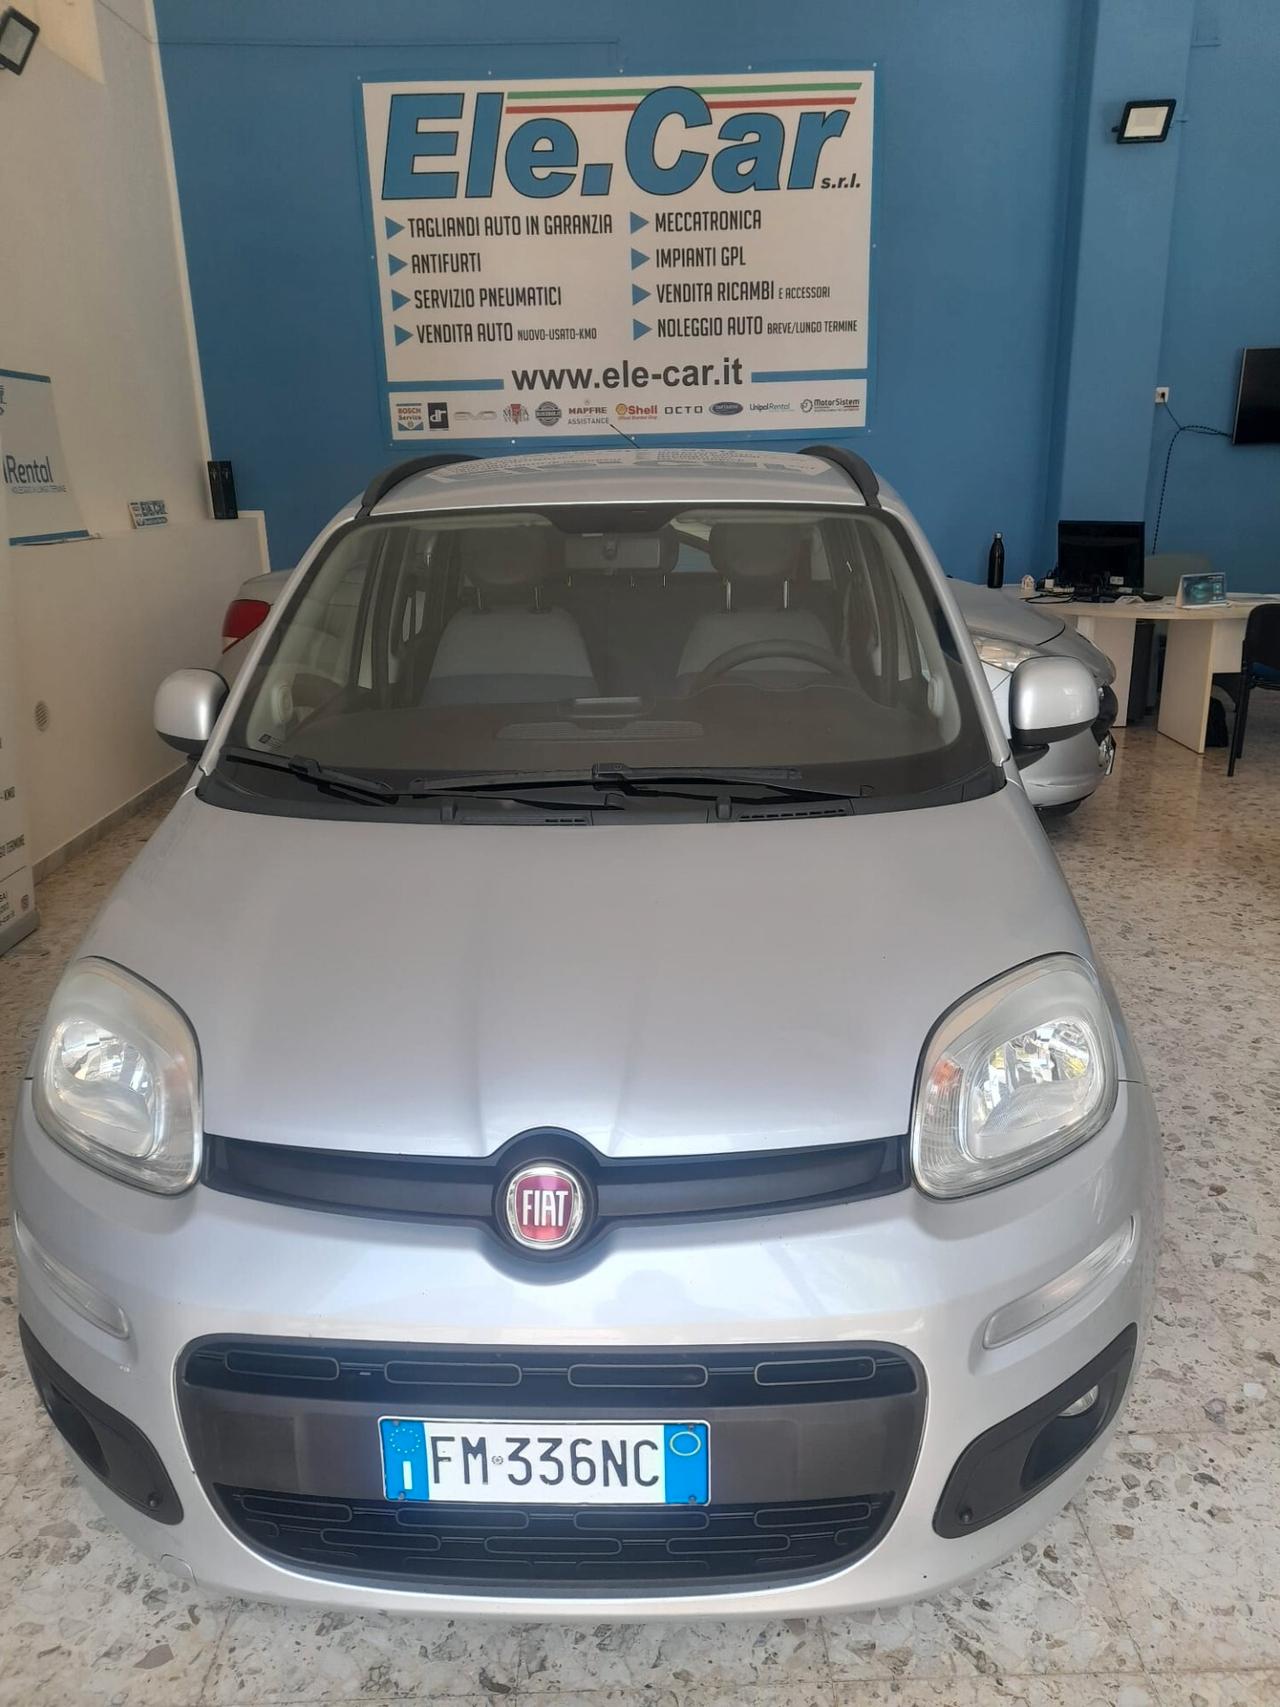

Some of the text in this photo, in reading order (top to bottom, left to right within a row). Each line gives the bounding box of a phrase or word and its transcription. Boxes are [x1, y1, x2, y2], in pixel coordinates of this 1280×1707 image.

[820, 173, 861, 189] s.r.l.
[408, 214, 613, 238] TAGLIANDI AUTO IN GARANZIA
[655, 209, 762, 232] MECCATRONICA
[411, 252, 481, 274] ANTIFURTI
[656, 246, 746, 268] IMPIANTI GPL
[414, 286, 562, 309] SERVIZIO PNEUMATICI
[656, 280, 831, 303] VENDITA RICAMBI E ACCESSORI
[416, 324, 473, 344] VENDITA
[477, 322, 513, 342] AUTO
[657, 316, 858, 338] NOLEGGIO AUTO BREVE/LUNGO TERMINE
[511, 357, 743, 391] www.ele-car.it
[568, 406, 608, 414] MAPFRE
[568, 417, 610, 425] ASSISTANCE
[628, 405, 658, 415] Shell
[664, 405, 703, 415] OCTO
[522, 1189, 569, 1227] FIAT
[430, 1436, 489, 1486] FM
[505, 1437, 660, 1488] 336NC
